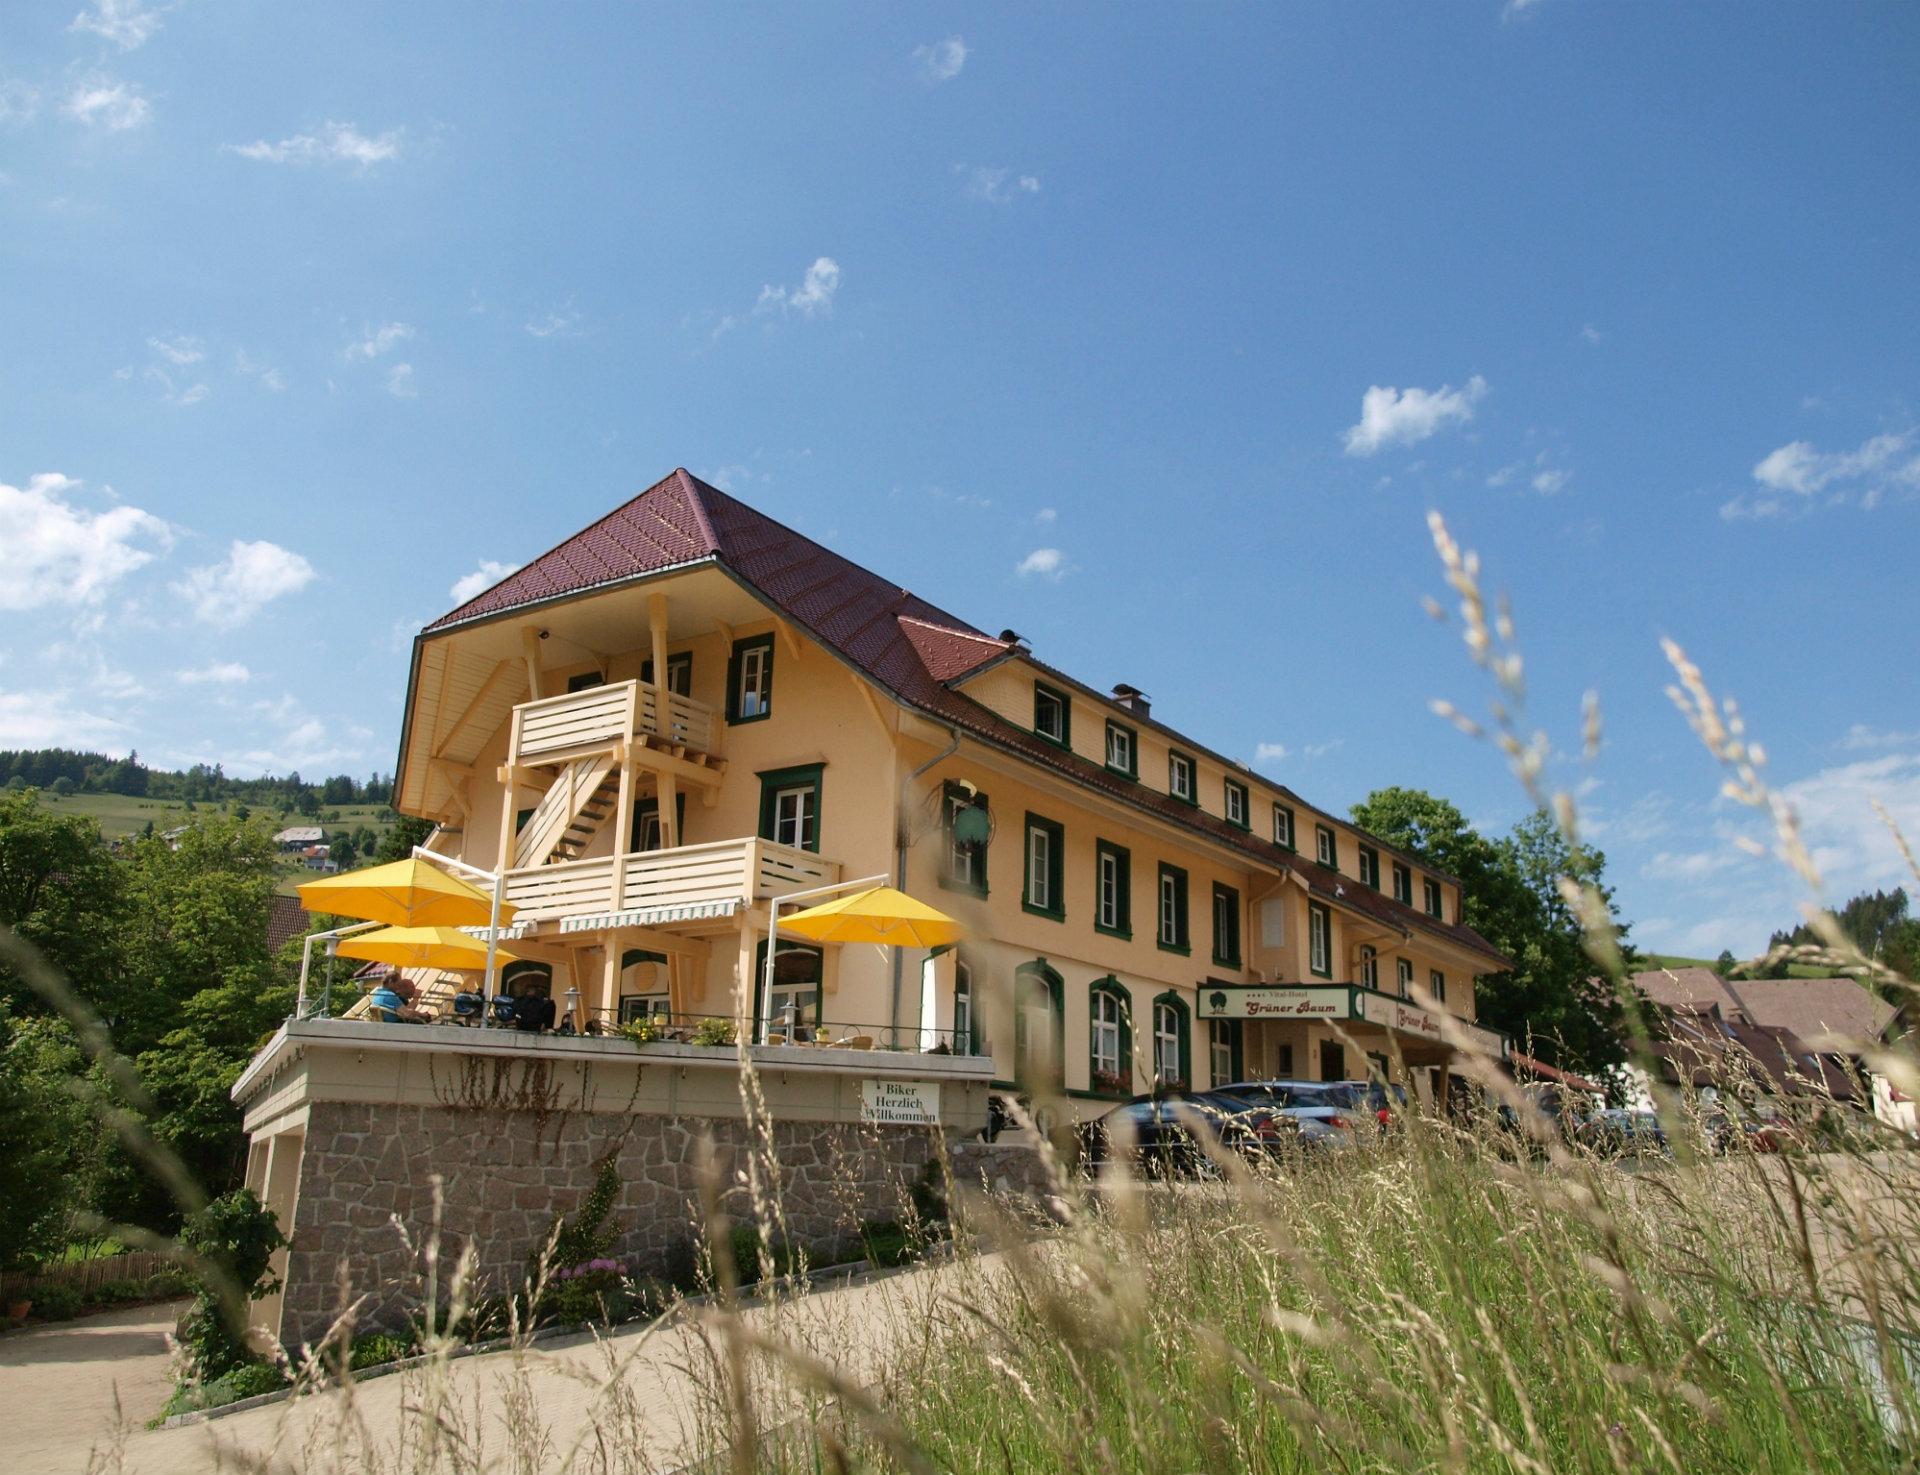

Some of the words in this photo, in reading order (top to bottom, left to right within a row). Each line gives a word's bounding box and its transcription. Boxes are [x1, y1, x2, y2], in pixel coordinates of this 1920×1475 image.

[1246, 1001, 1293, 1015] Grüner
[1296, 1000, 1336, 1014] Baum
[886, 1084, 917, 1095] Biker
[876, 1096, 923, 1108] Herzlich
[865, 1108, 936, 1122] Willkommen
